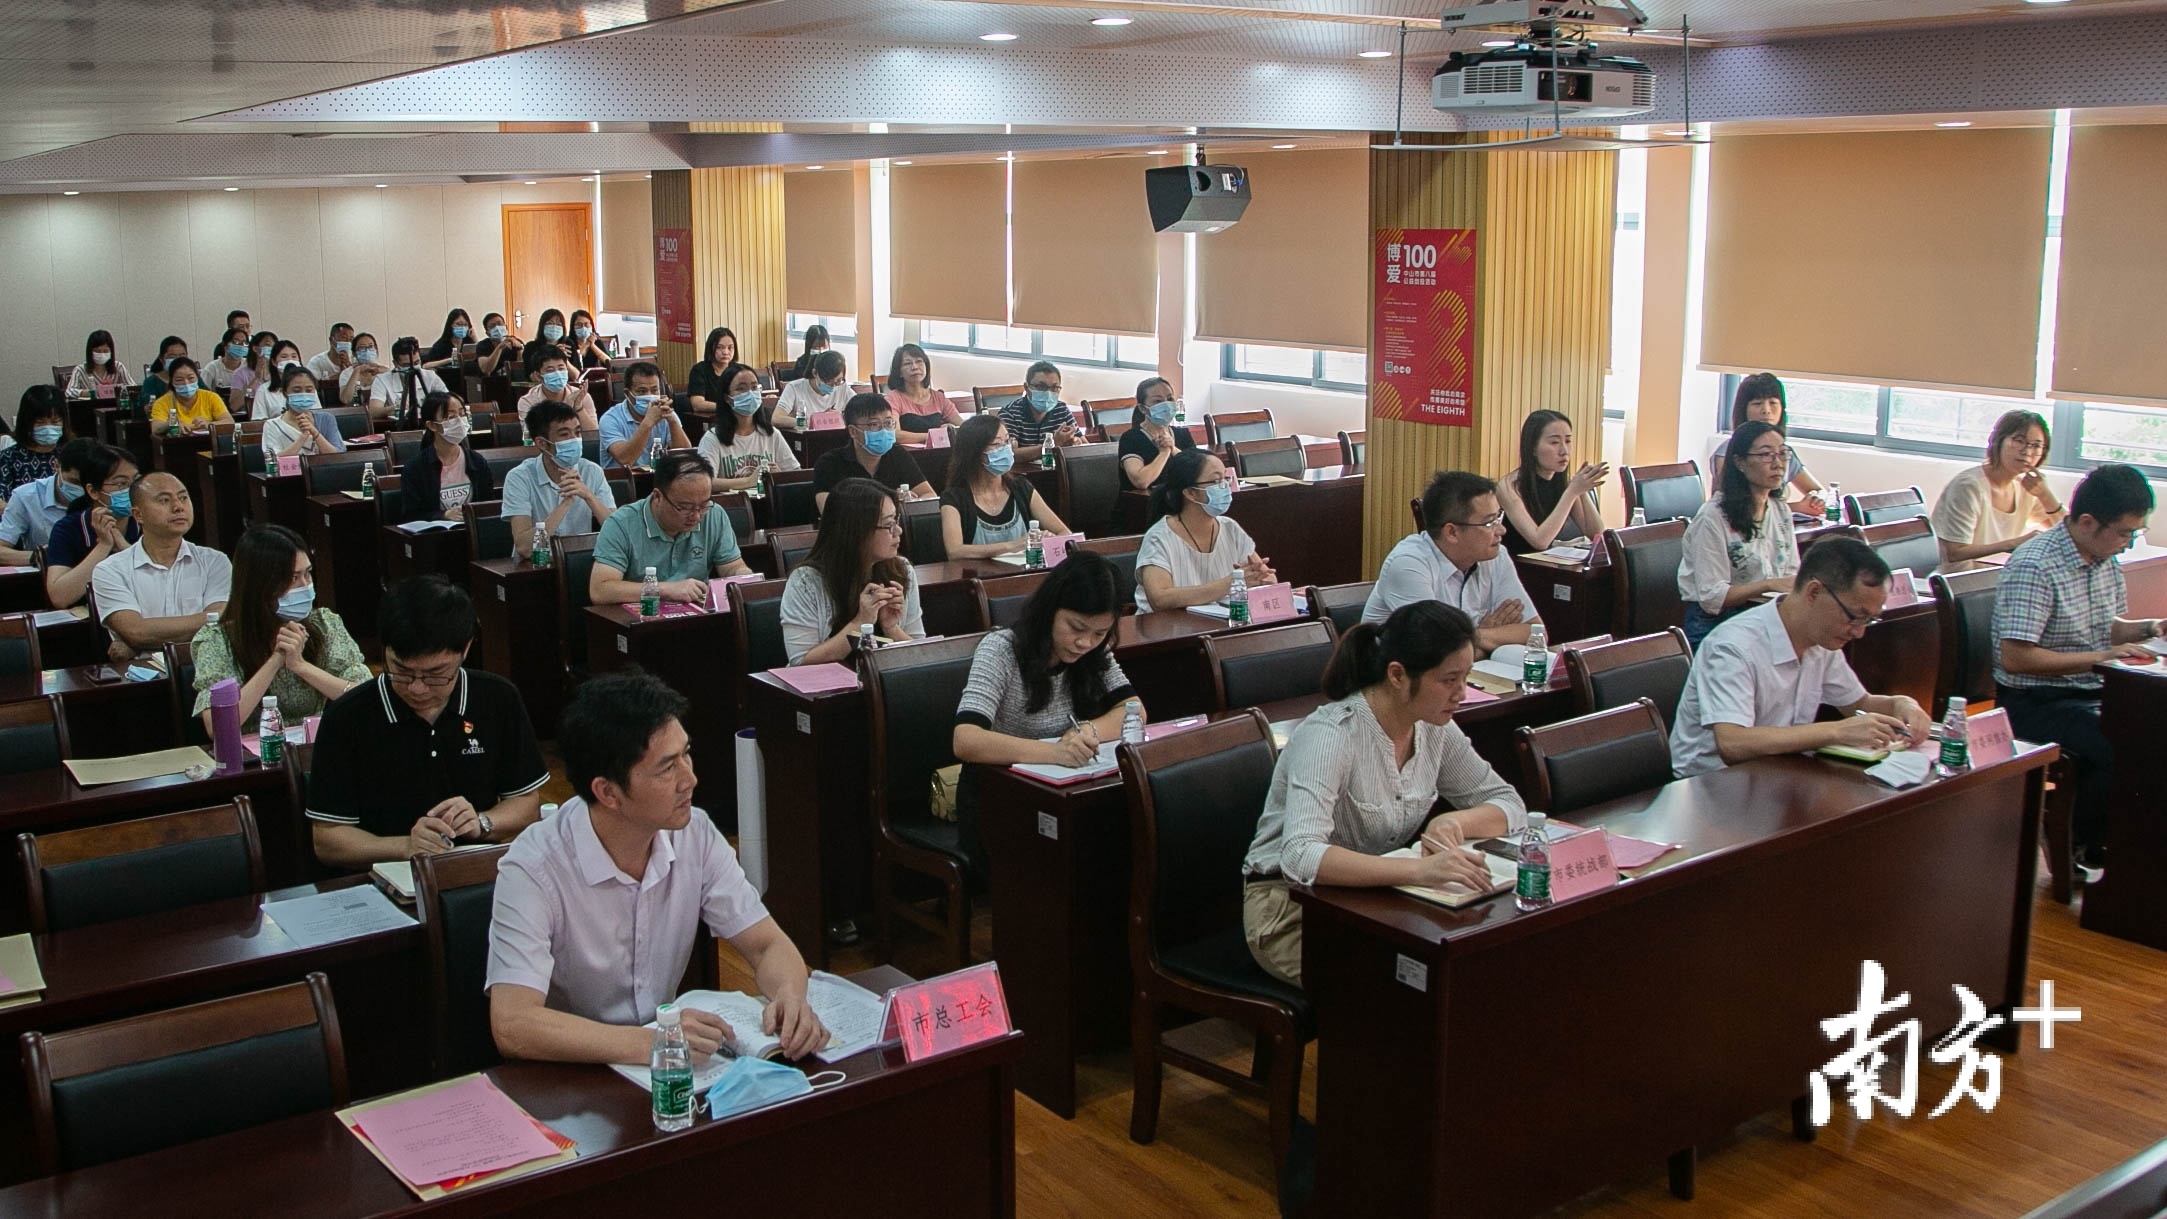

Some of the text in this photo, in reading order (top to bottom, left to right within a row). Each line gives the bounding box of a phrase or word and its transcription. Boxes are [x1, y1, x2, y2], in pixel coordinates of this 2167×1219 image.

[1386, 242, 1401, 284] 博爱
[1403, 244, 1437, 269] 100
[1420, 403, 1466, 416] THE EIGHTH
[440, 487, 468, 500] GUESS
[1553, 853, 1609, 882] 市委统战部
[912, 994, 992, 1035] 市总工会
